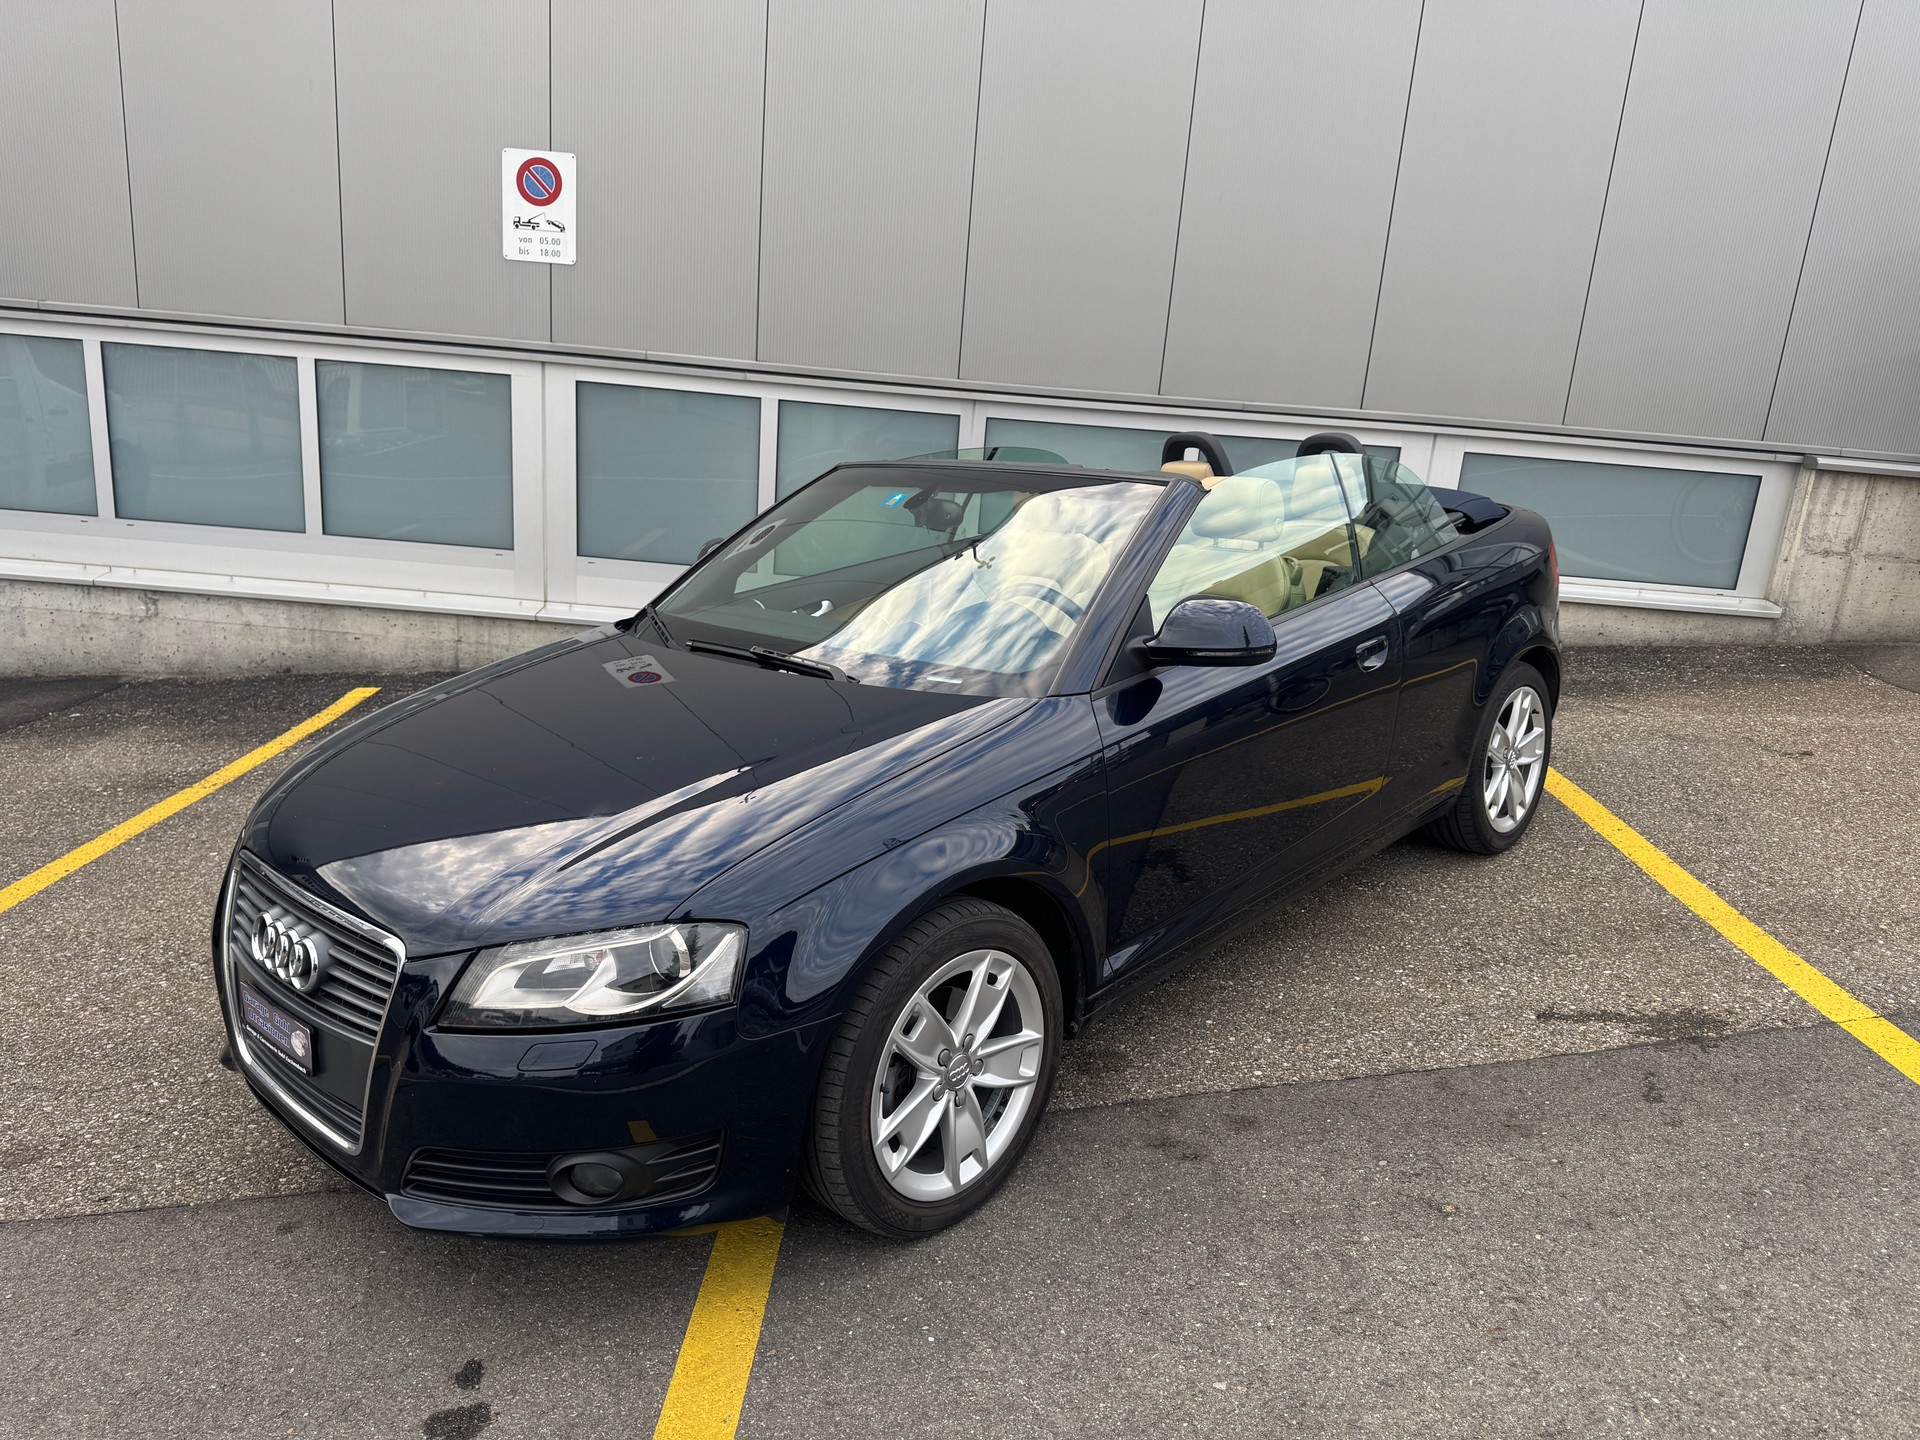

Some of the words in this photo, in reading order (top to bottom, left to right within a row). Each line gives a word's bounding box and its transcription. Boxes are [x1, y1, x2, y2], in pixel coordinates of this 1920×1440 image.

[539, 237, 561, 245] 05.00
[518, 247, 530, 255] bis
[540, 249, 561, 257] 18.00
[243, 991, 269, 1018] Garage
